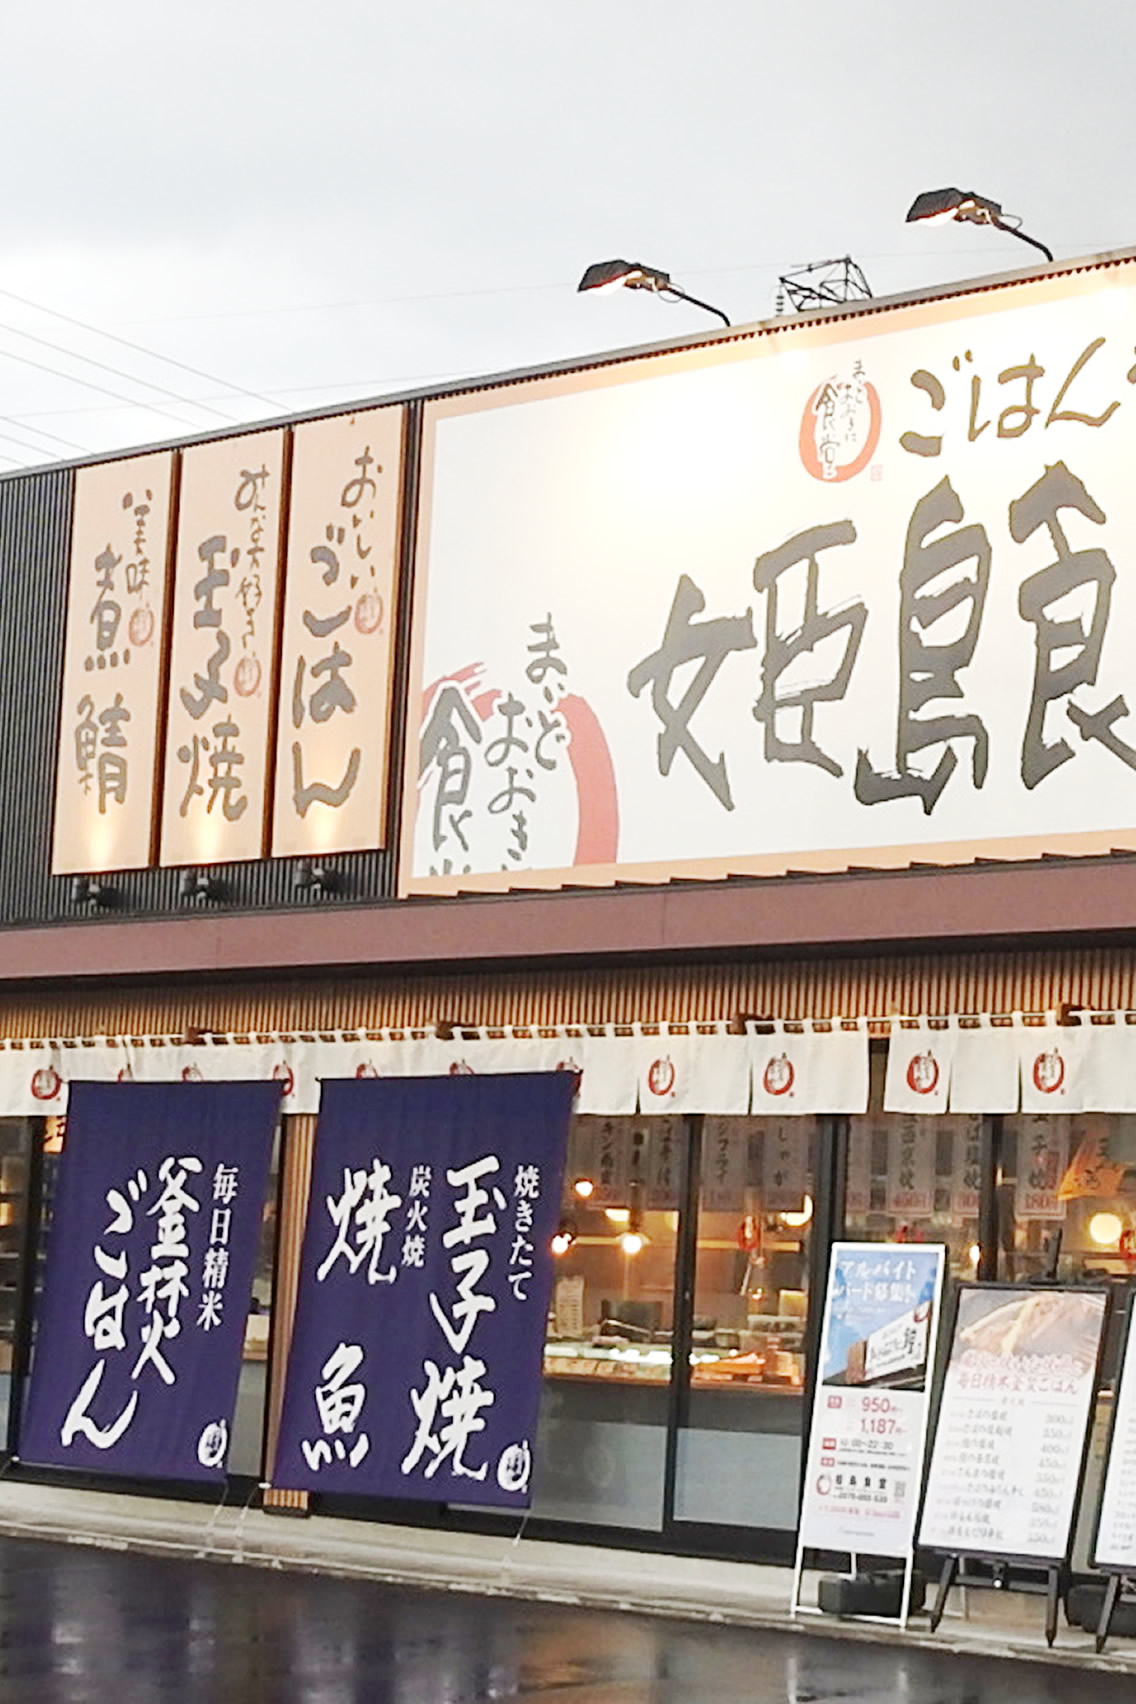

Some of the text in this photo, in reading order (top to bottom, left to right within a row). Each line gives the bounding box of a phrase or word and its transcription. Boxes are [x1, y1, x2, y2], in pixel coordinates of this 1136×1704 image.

[341, 446, 382, 589] おいしい
[177, 535, 249, 821] 玉子焼
[292, 522, 360, 818] ごはん
[525, 612, 567, 770] まいど
[420, 686, 482, 876] 食
[484, 691, 537, 872] おおき
[197, 1163, 238, 1331] 毎日精米
[402, 1165, 431, 1268] 炭火焼
[507, 1165, 540, 1300] 焼きたて
[841, 1260, 916, 1281] アルバイト
[61, 1169, 147, 1449] ごはん
[303, 1158, 401, 1471] 焼魚
[402, 1156, 506, 1480] 玉子焼
